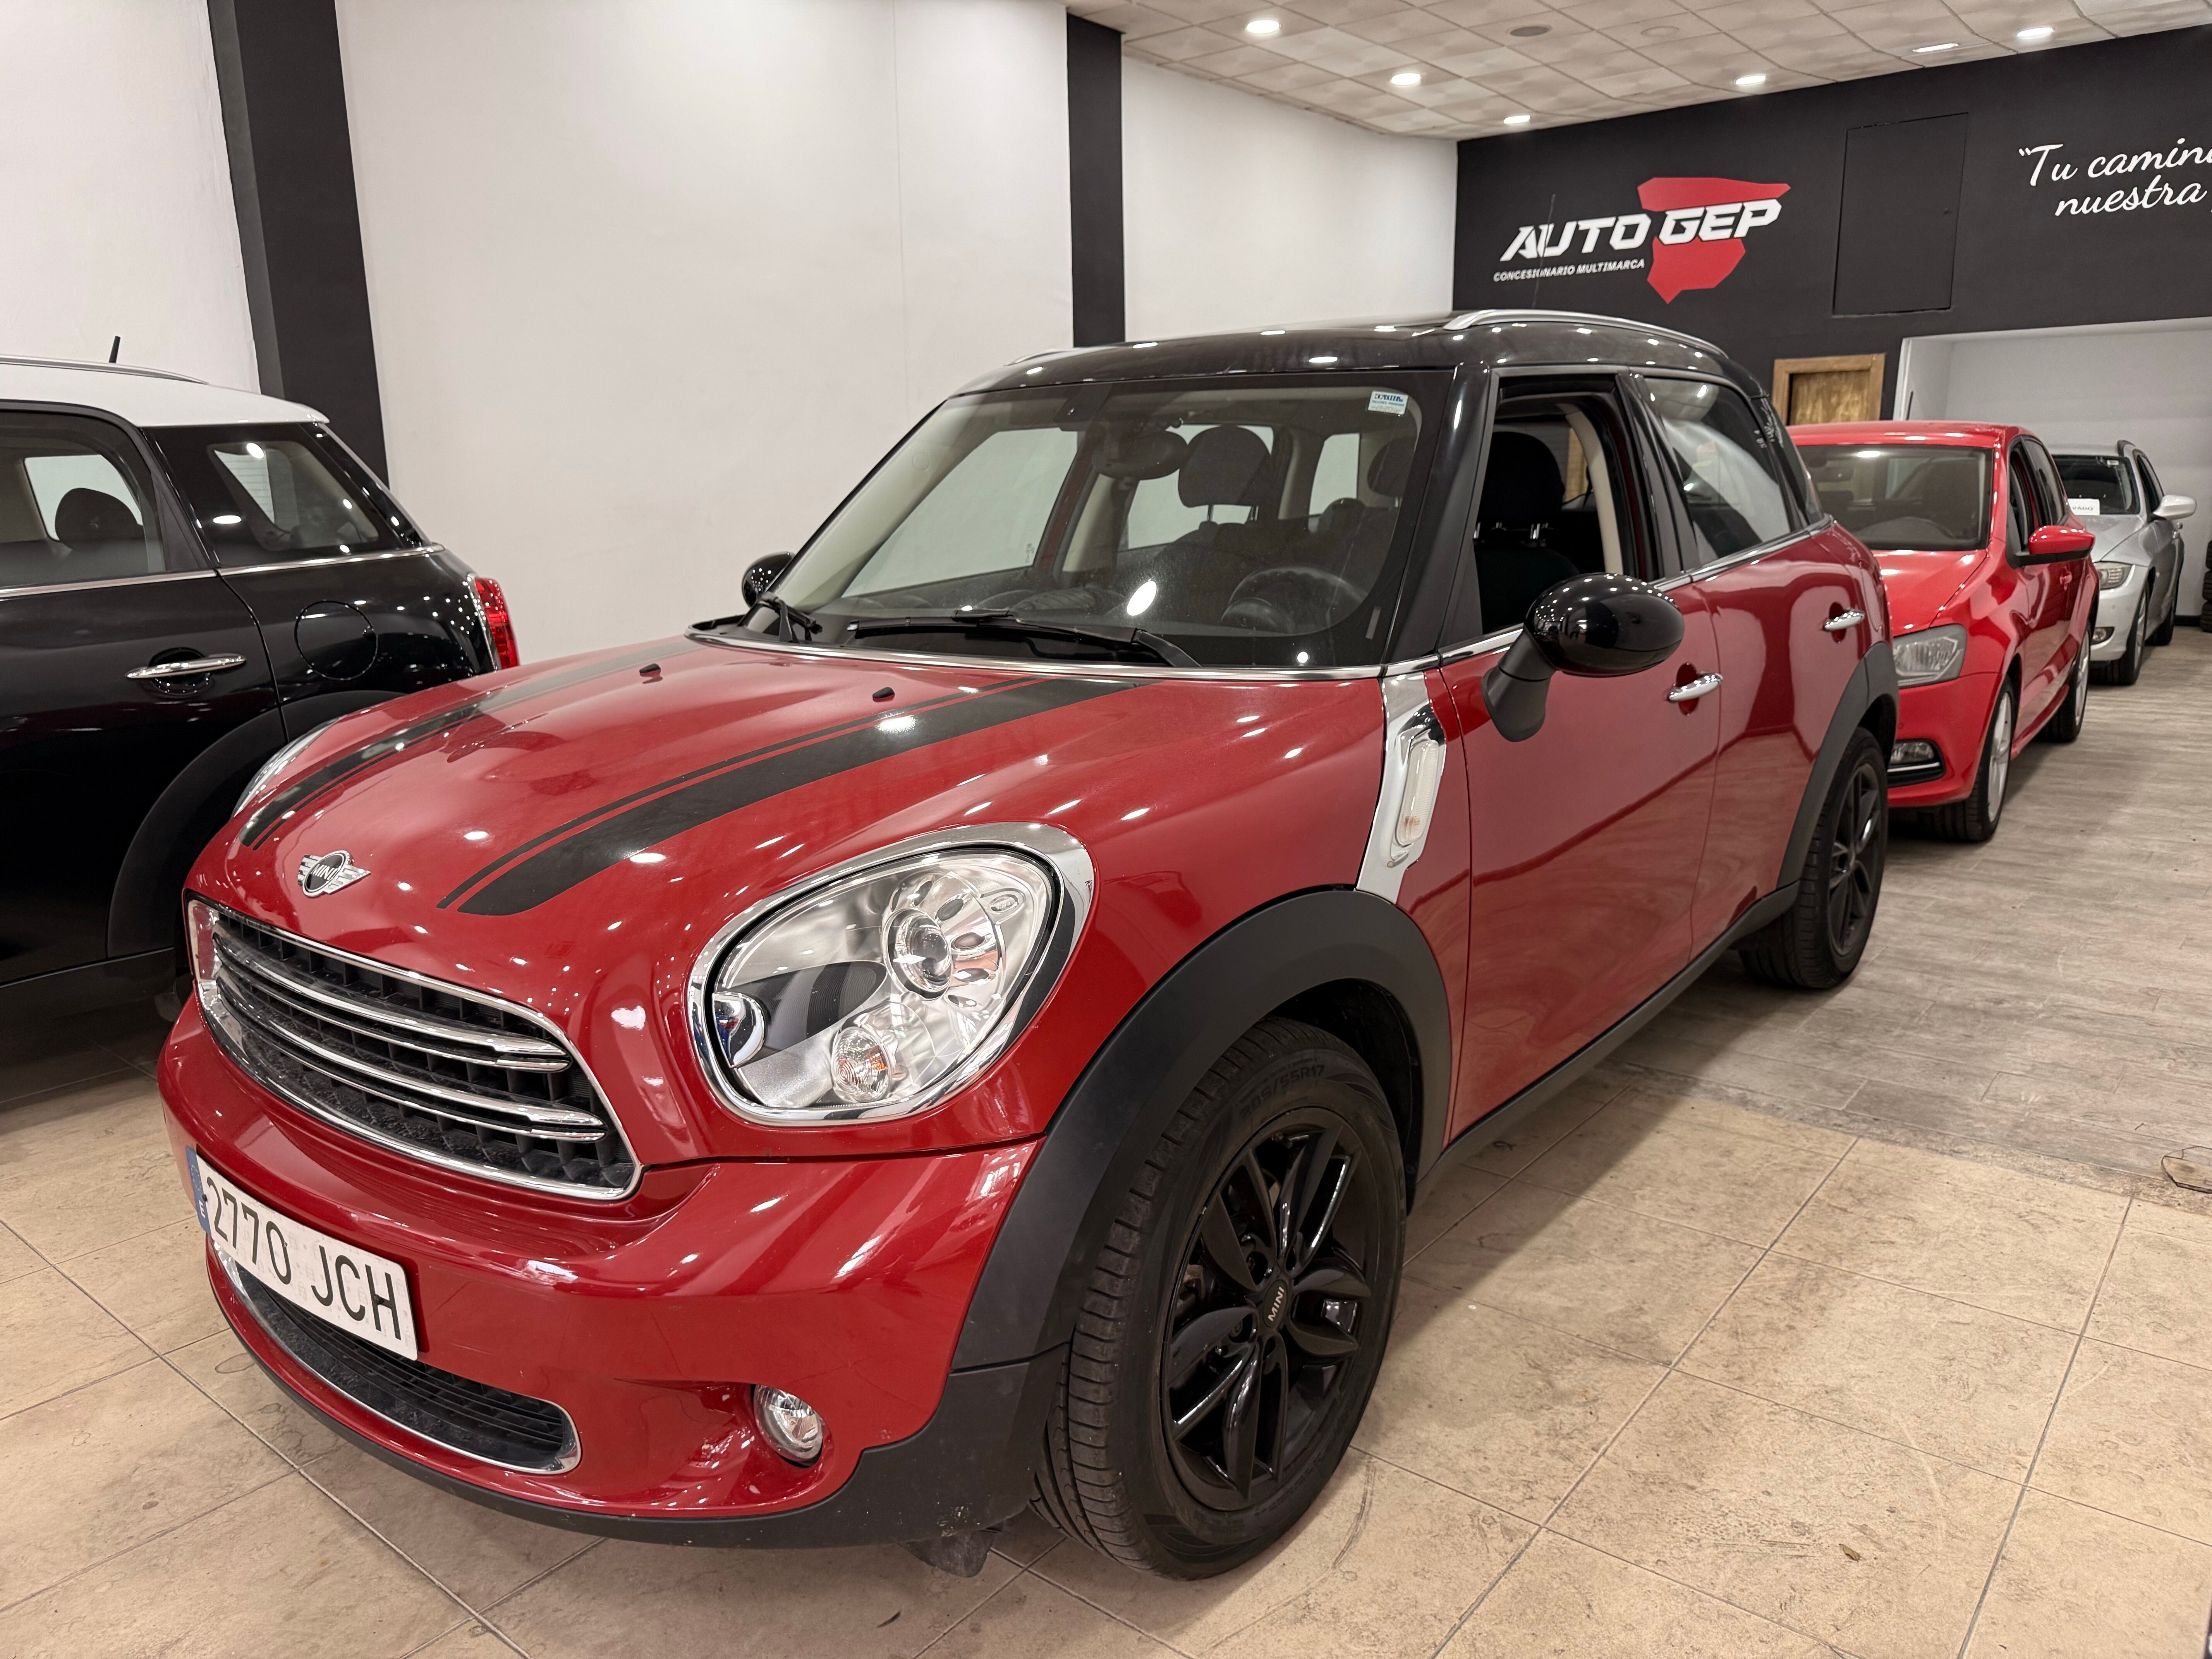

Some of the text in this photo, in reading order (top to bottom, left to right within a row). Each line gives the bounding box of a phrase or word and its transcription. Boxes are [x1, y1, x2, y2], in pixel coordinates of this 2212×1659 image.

[2055, 174, 2207, 216] nuestra
[1500, 199, 1782, 261] AUTO GEP
[1576, 258, 1645, 274] MULTIMARCA
[311, 864, 338, 880] MINI
[198, 1200, 205, 1218] E
[207, 1177, 402, 1340] 2770 JCH
[1267, 1286, 1285, 1321] MINI
